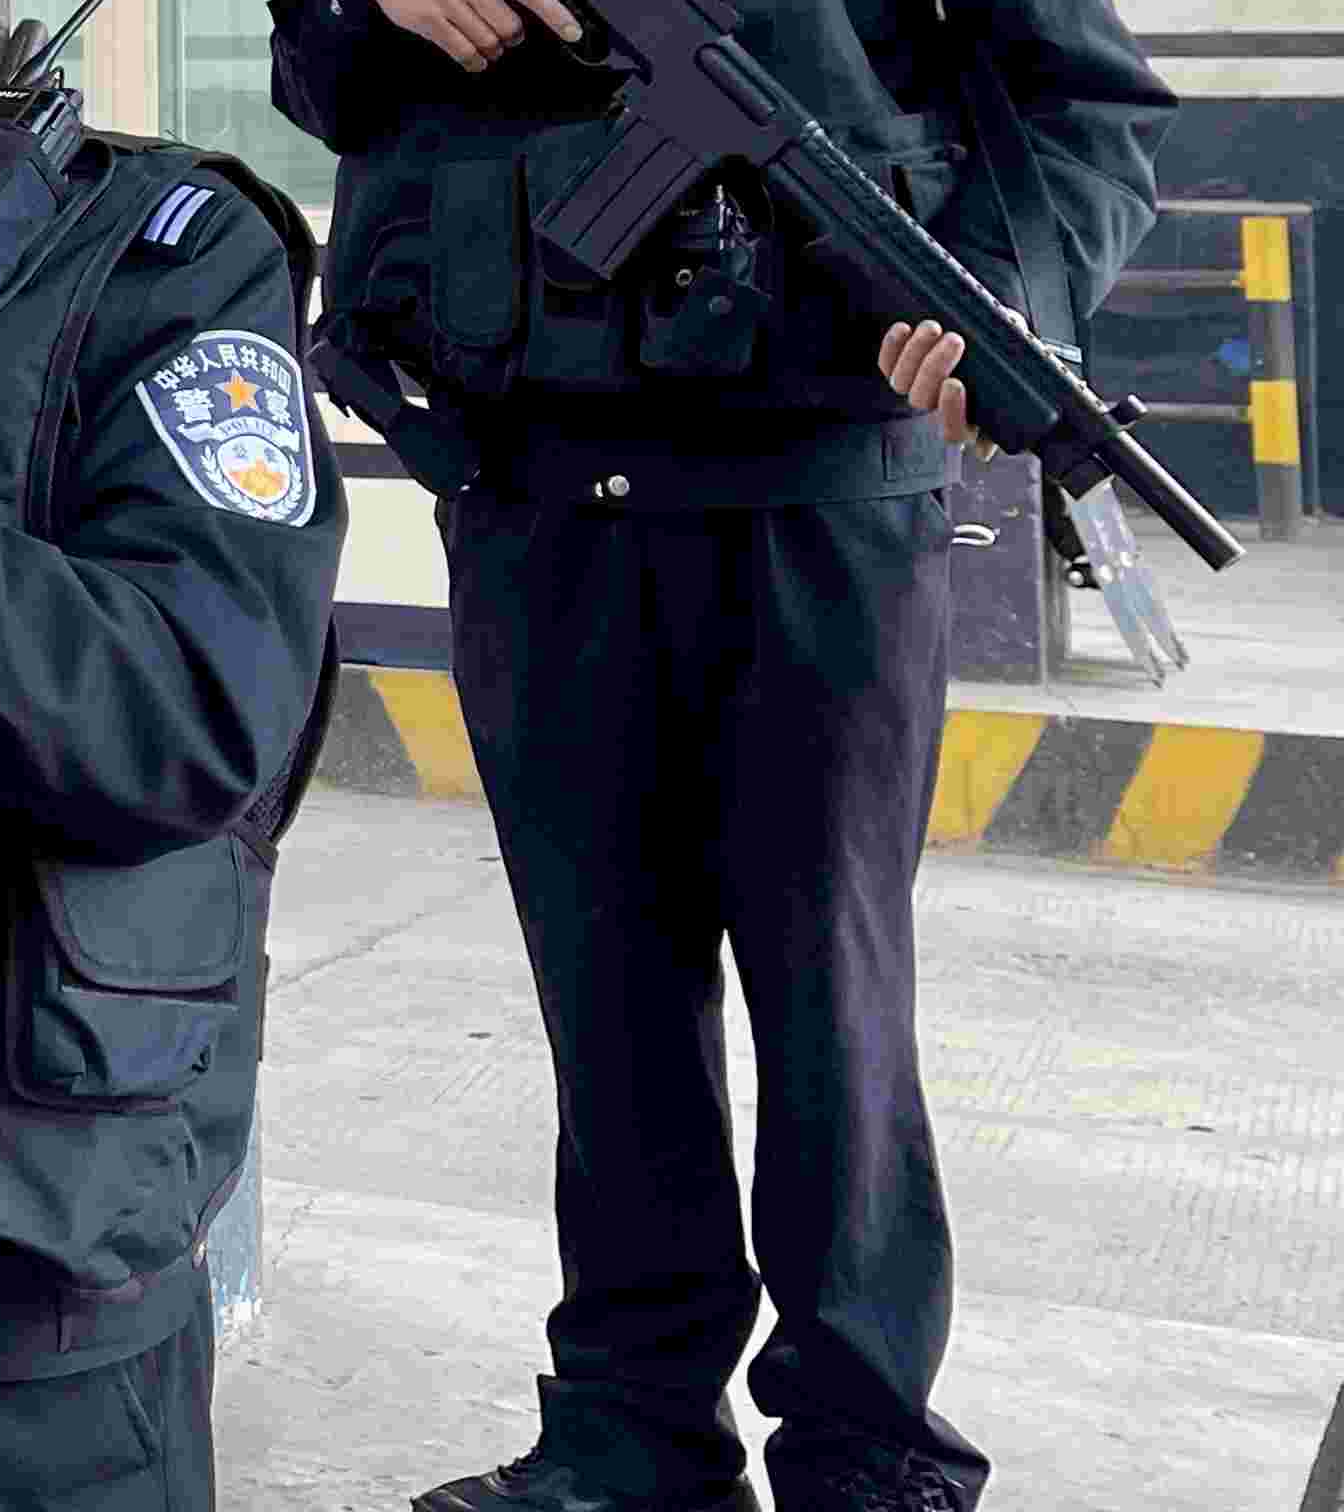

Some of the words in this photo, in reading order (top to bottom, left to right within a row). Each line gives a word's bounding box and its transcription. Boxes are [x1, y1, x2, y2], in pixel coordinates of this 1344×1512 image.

[152, 343, 292, 396] 中华人民共和国
